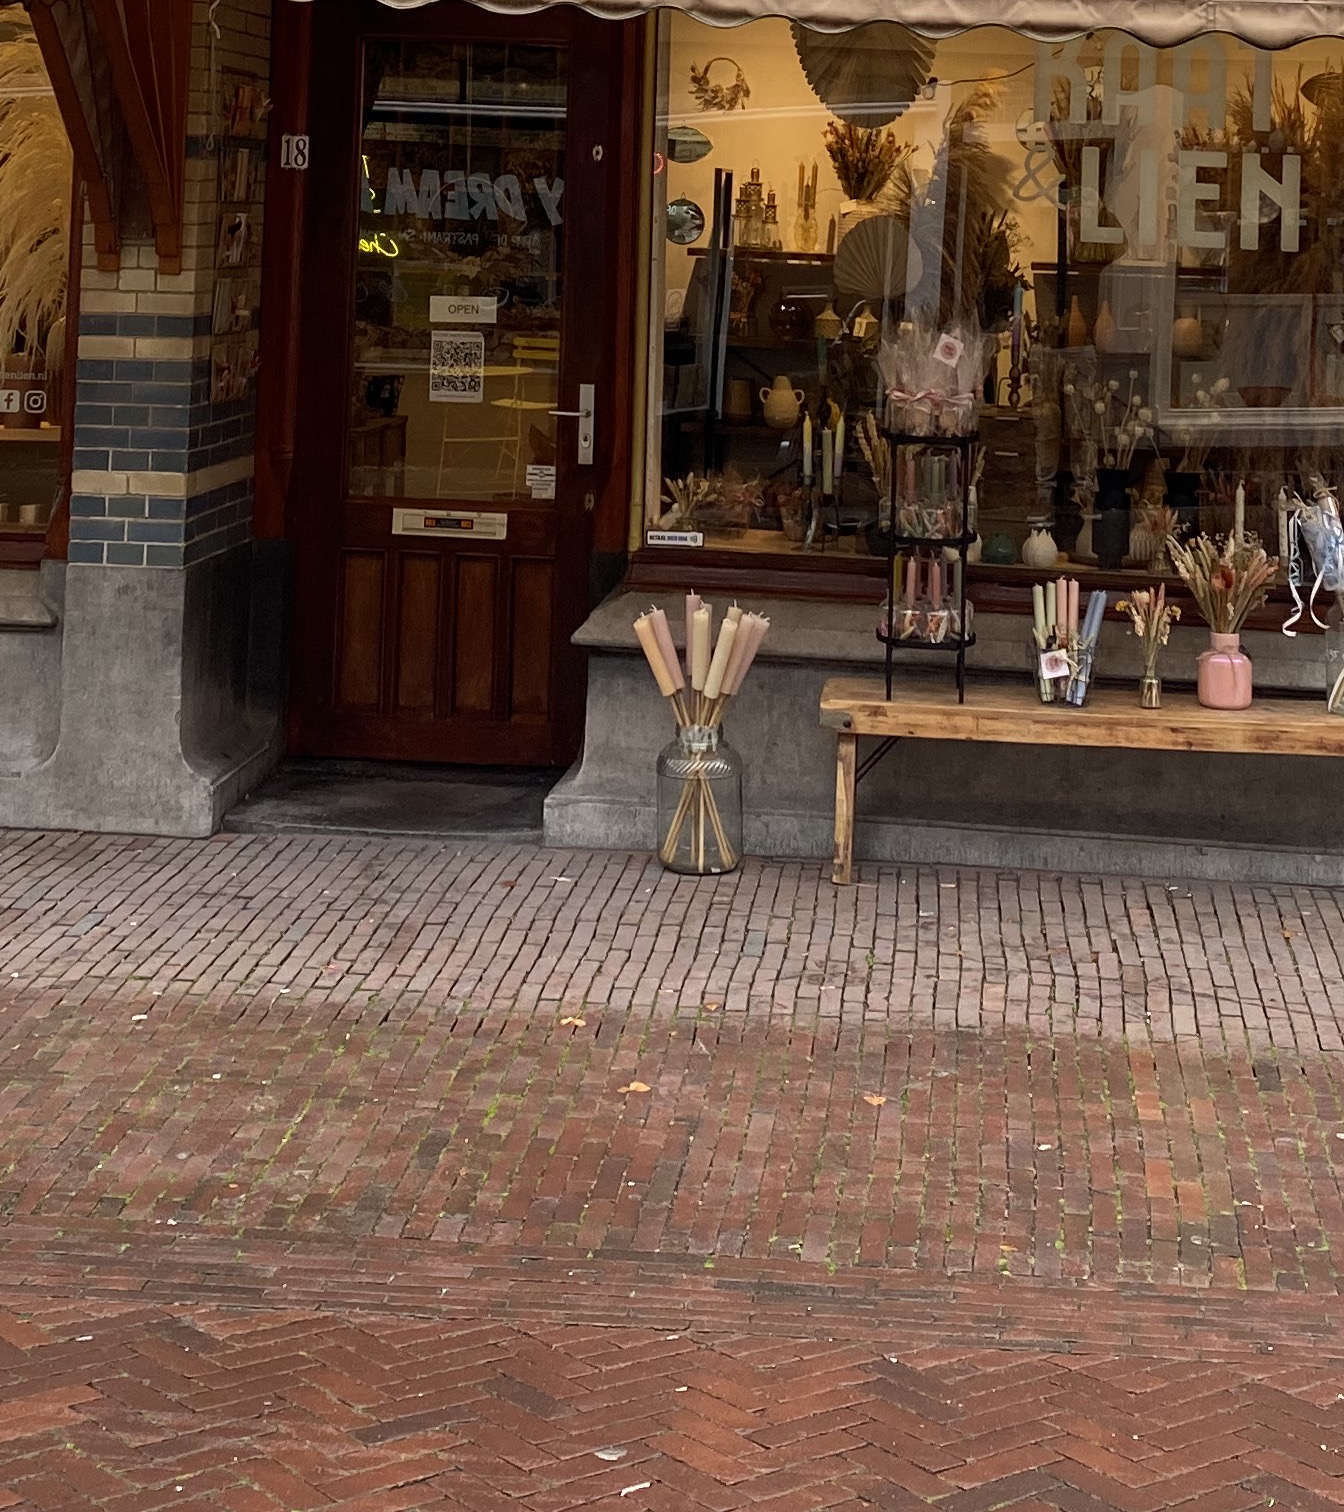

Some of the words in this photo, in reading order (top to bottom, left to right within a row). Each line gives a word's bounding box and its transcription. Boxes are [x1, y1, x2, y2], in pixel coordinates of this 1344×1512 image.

[284, 138, 307, 167] 18
[1080, 146, 1301, 252] LIEN
[447, 303, 480, 315] OPEN
